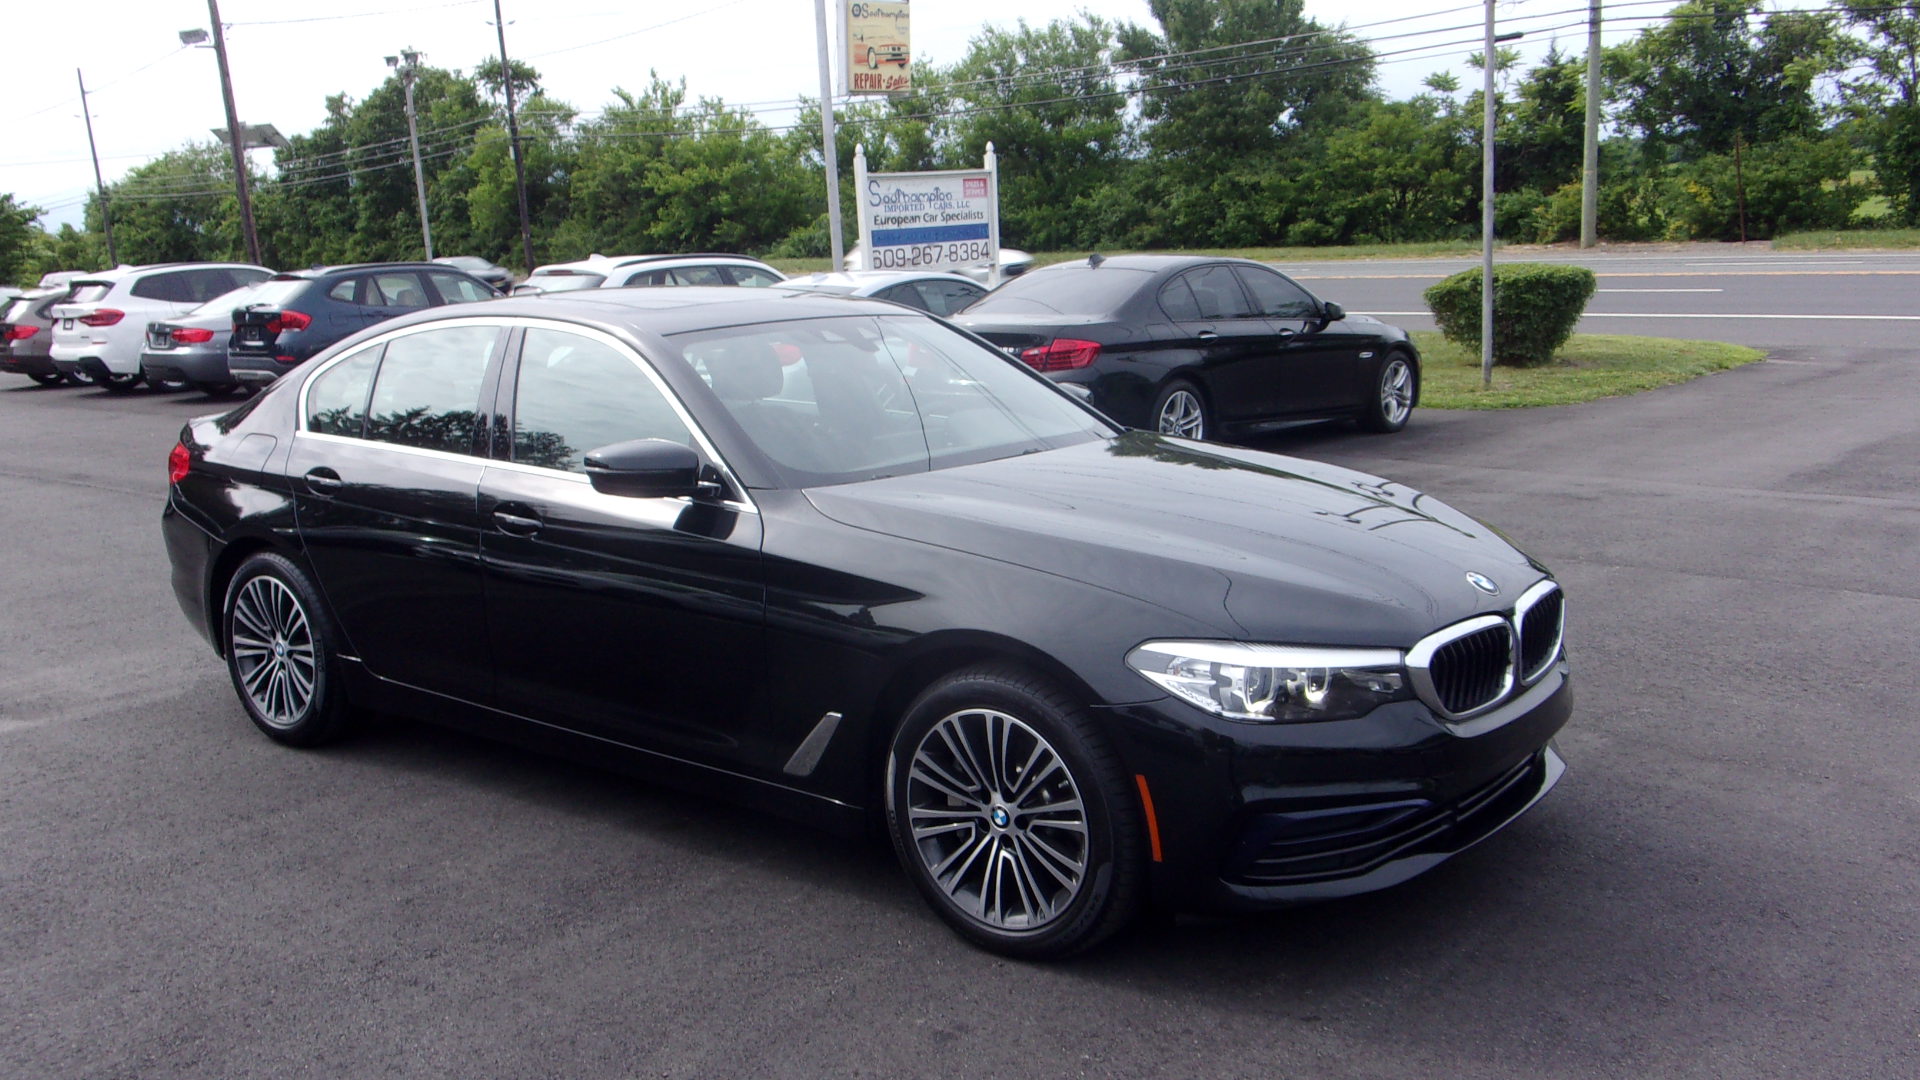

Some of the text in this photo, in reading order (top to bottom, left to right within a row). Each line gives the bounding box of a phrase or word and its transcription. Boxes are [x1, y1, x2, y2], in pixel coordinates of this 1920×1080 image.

[854, 73, 882, 89] REPAIR
[868, 180, 953, 208] Southampton
[884, 202, 925, 213] IMPORTED
[957, 200, 970, 209] LLC
[874, 209, 985, 227] European Car Specialists
[872, 242, 989, 269] 609-267-8384
